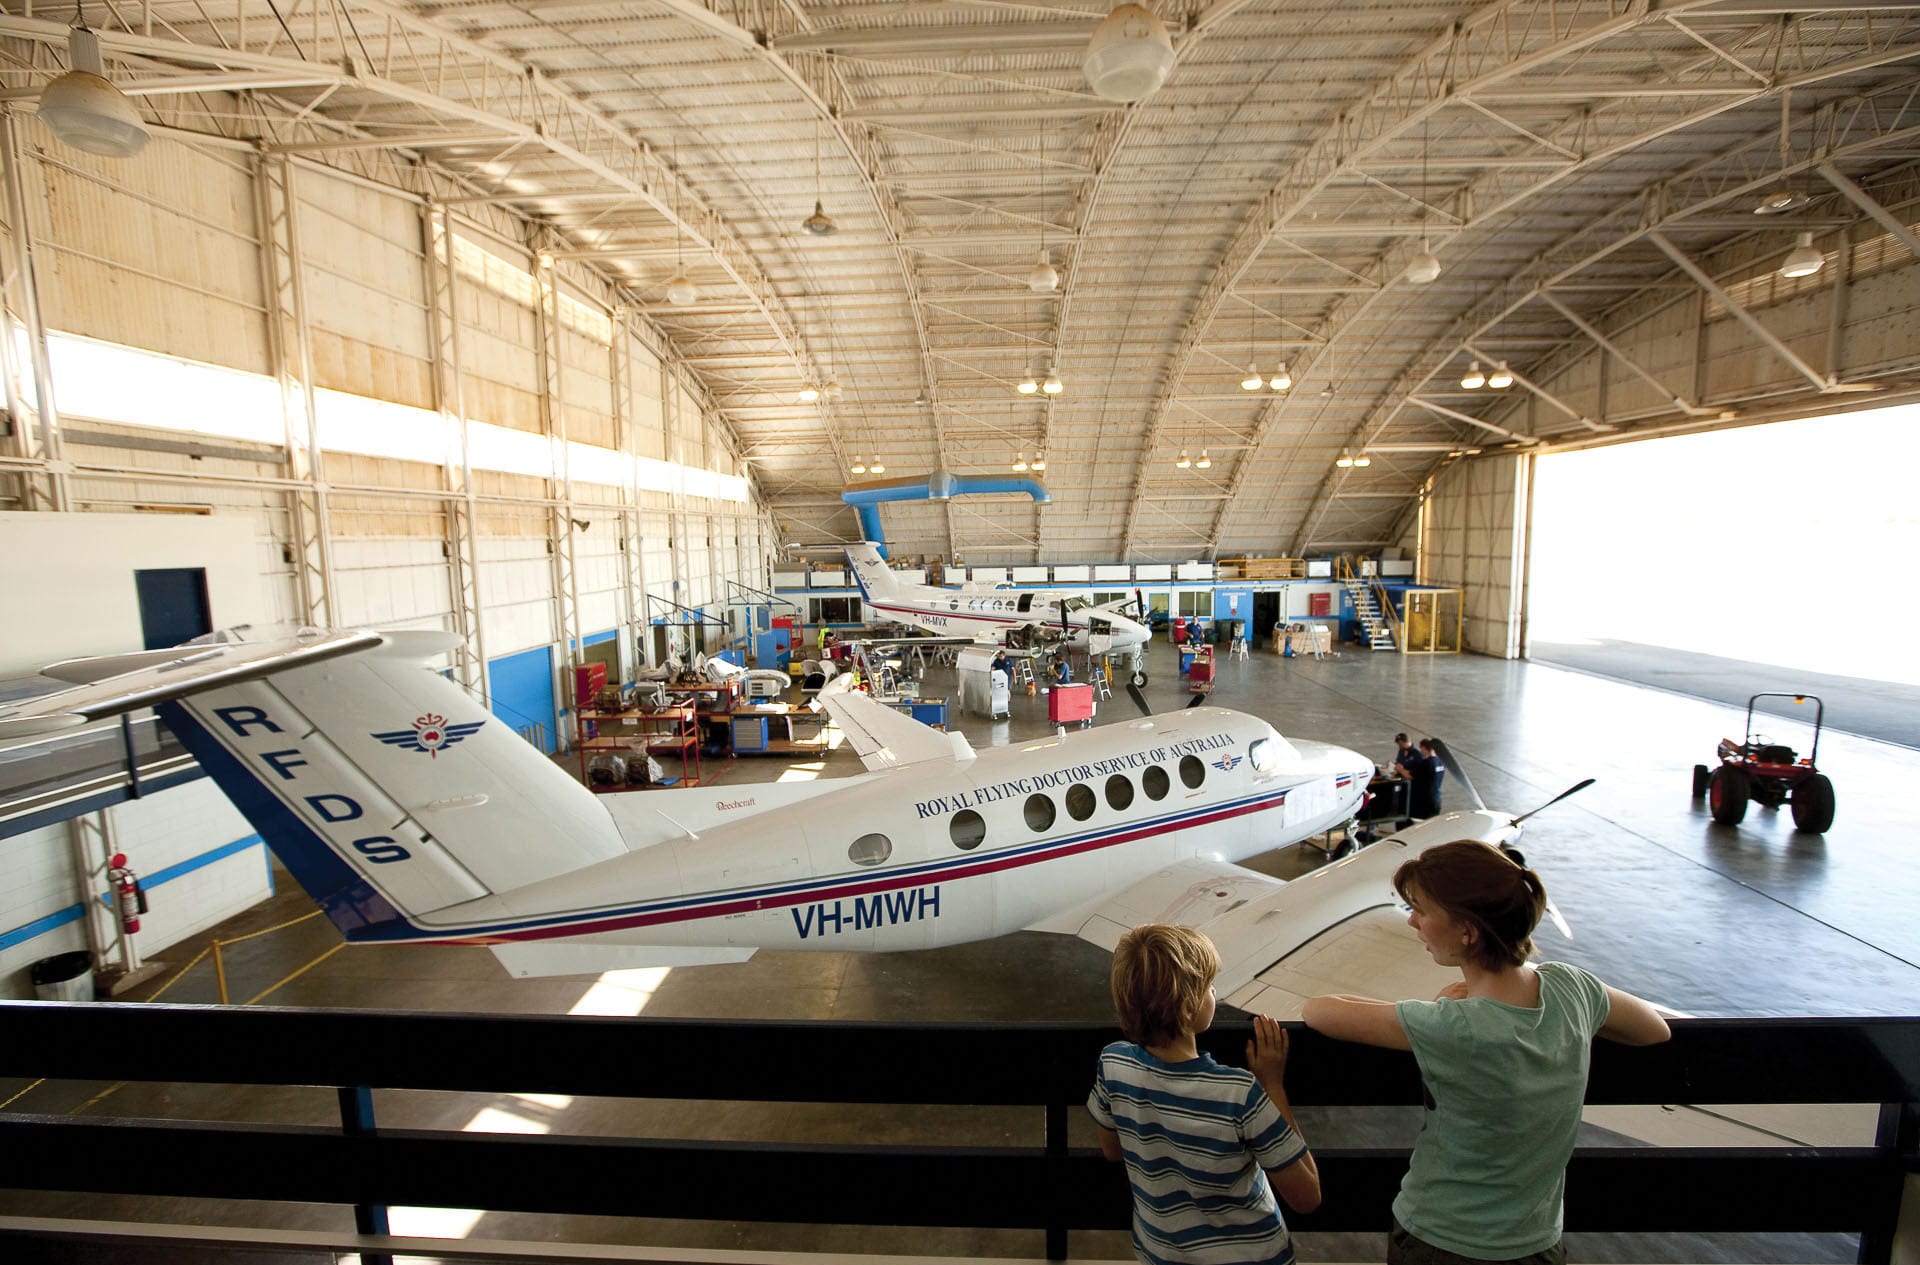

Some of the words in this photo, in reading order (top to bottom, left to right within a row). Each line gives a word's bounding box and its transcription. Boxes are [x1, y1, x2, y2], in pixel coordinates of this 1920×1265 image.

[213, 706, 411, 864] RFDS
[715, 798, 756, 811] Beechcraft
[914, 792, 974, 819] ROYAL
[973, 778, 1032, 805] FLYING
[1030, 764, 1096, 791] DOCTOR
[1093, 751, 1151, 777] SERVICE
[1150, 747, 1168, 763] OF
[1171, 733, 1235, 759] AUSTRALIA
[791, 885, 941, 939] VH-MWH
